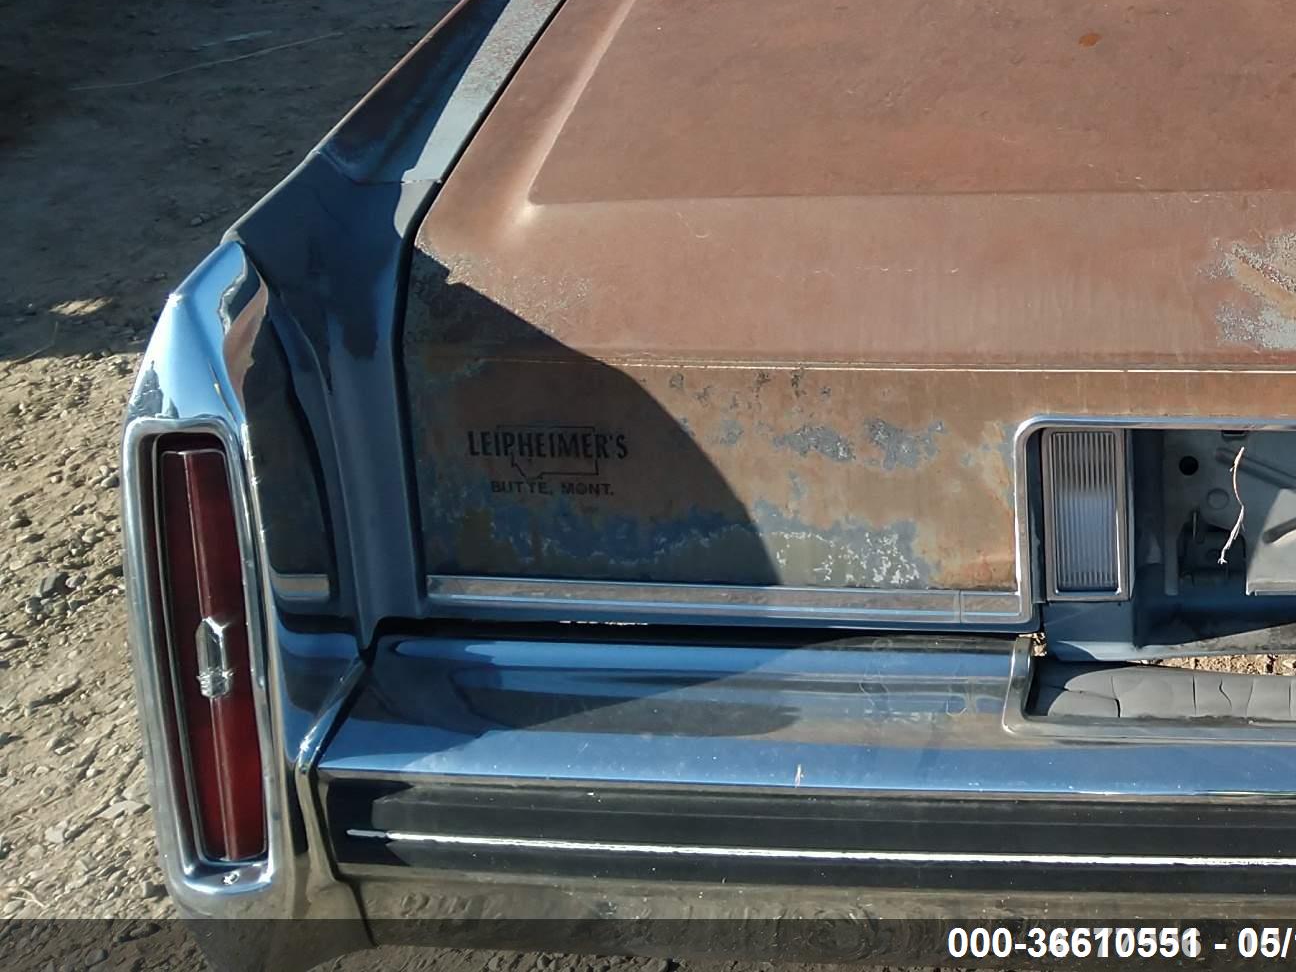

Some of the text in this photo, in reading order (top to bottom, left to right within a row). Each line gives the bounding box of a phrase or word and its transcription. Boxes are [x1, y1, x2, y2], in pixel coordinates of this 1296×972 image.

[467, 430, 629, 460] LEIPHEIMER'S
[490, 480, 615, 497] BUTTE, MONT.
